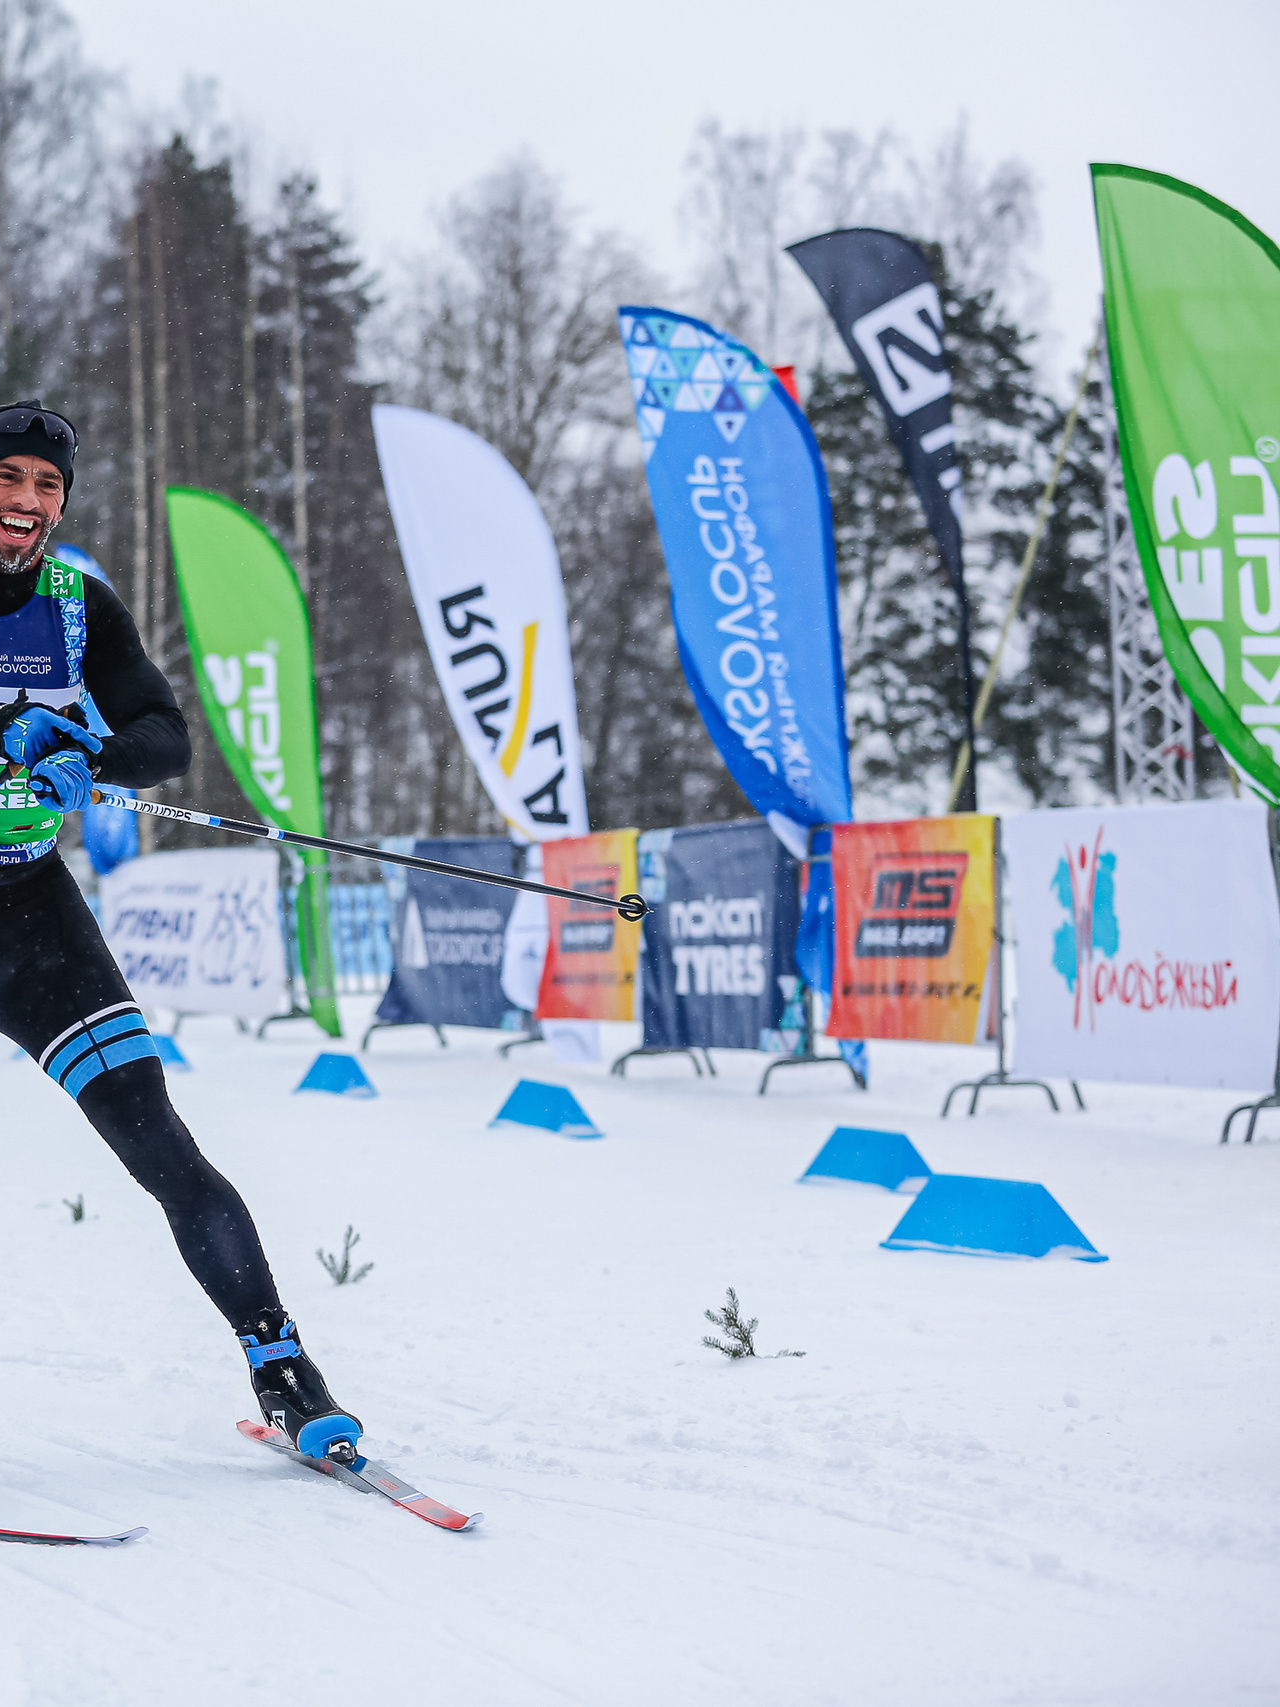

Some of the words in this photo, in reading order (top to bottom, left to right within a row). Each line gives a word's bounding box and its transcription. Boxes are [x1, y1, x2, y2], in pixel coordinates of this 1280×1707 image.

[50, 565, 75, 587] 51
[13, 655, 52, 664] МАРАФОН
[671, 943, 767, 997] TYRES
